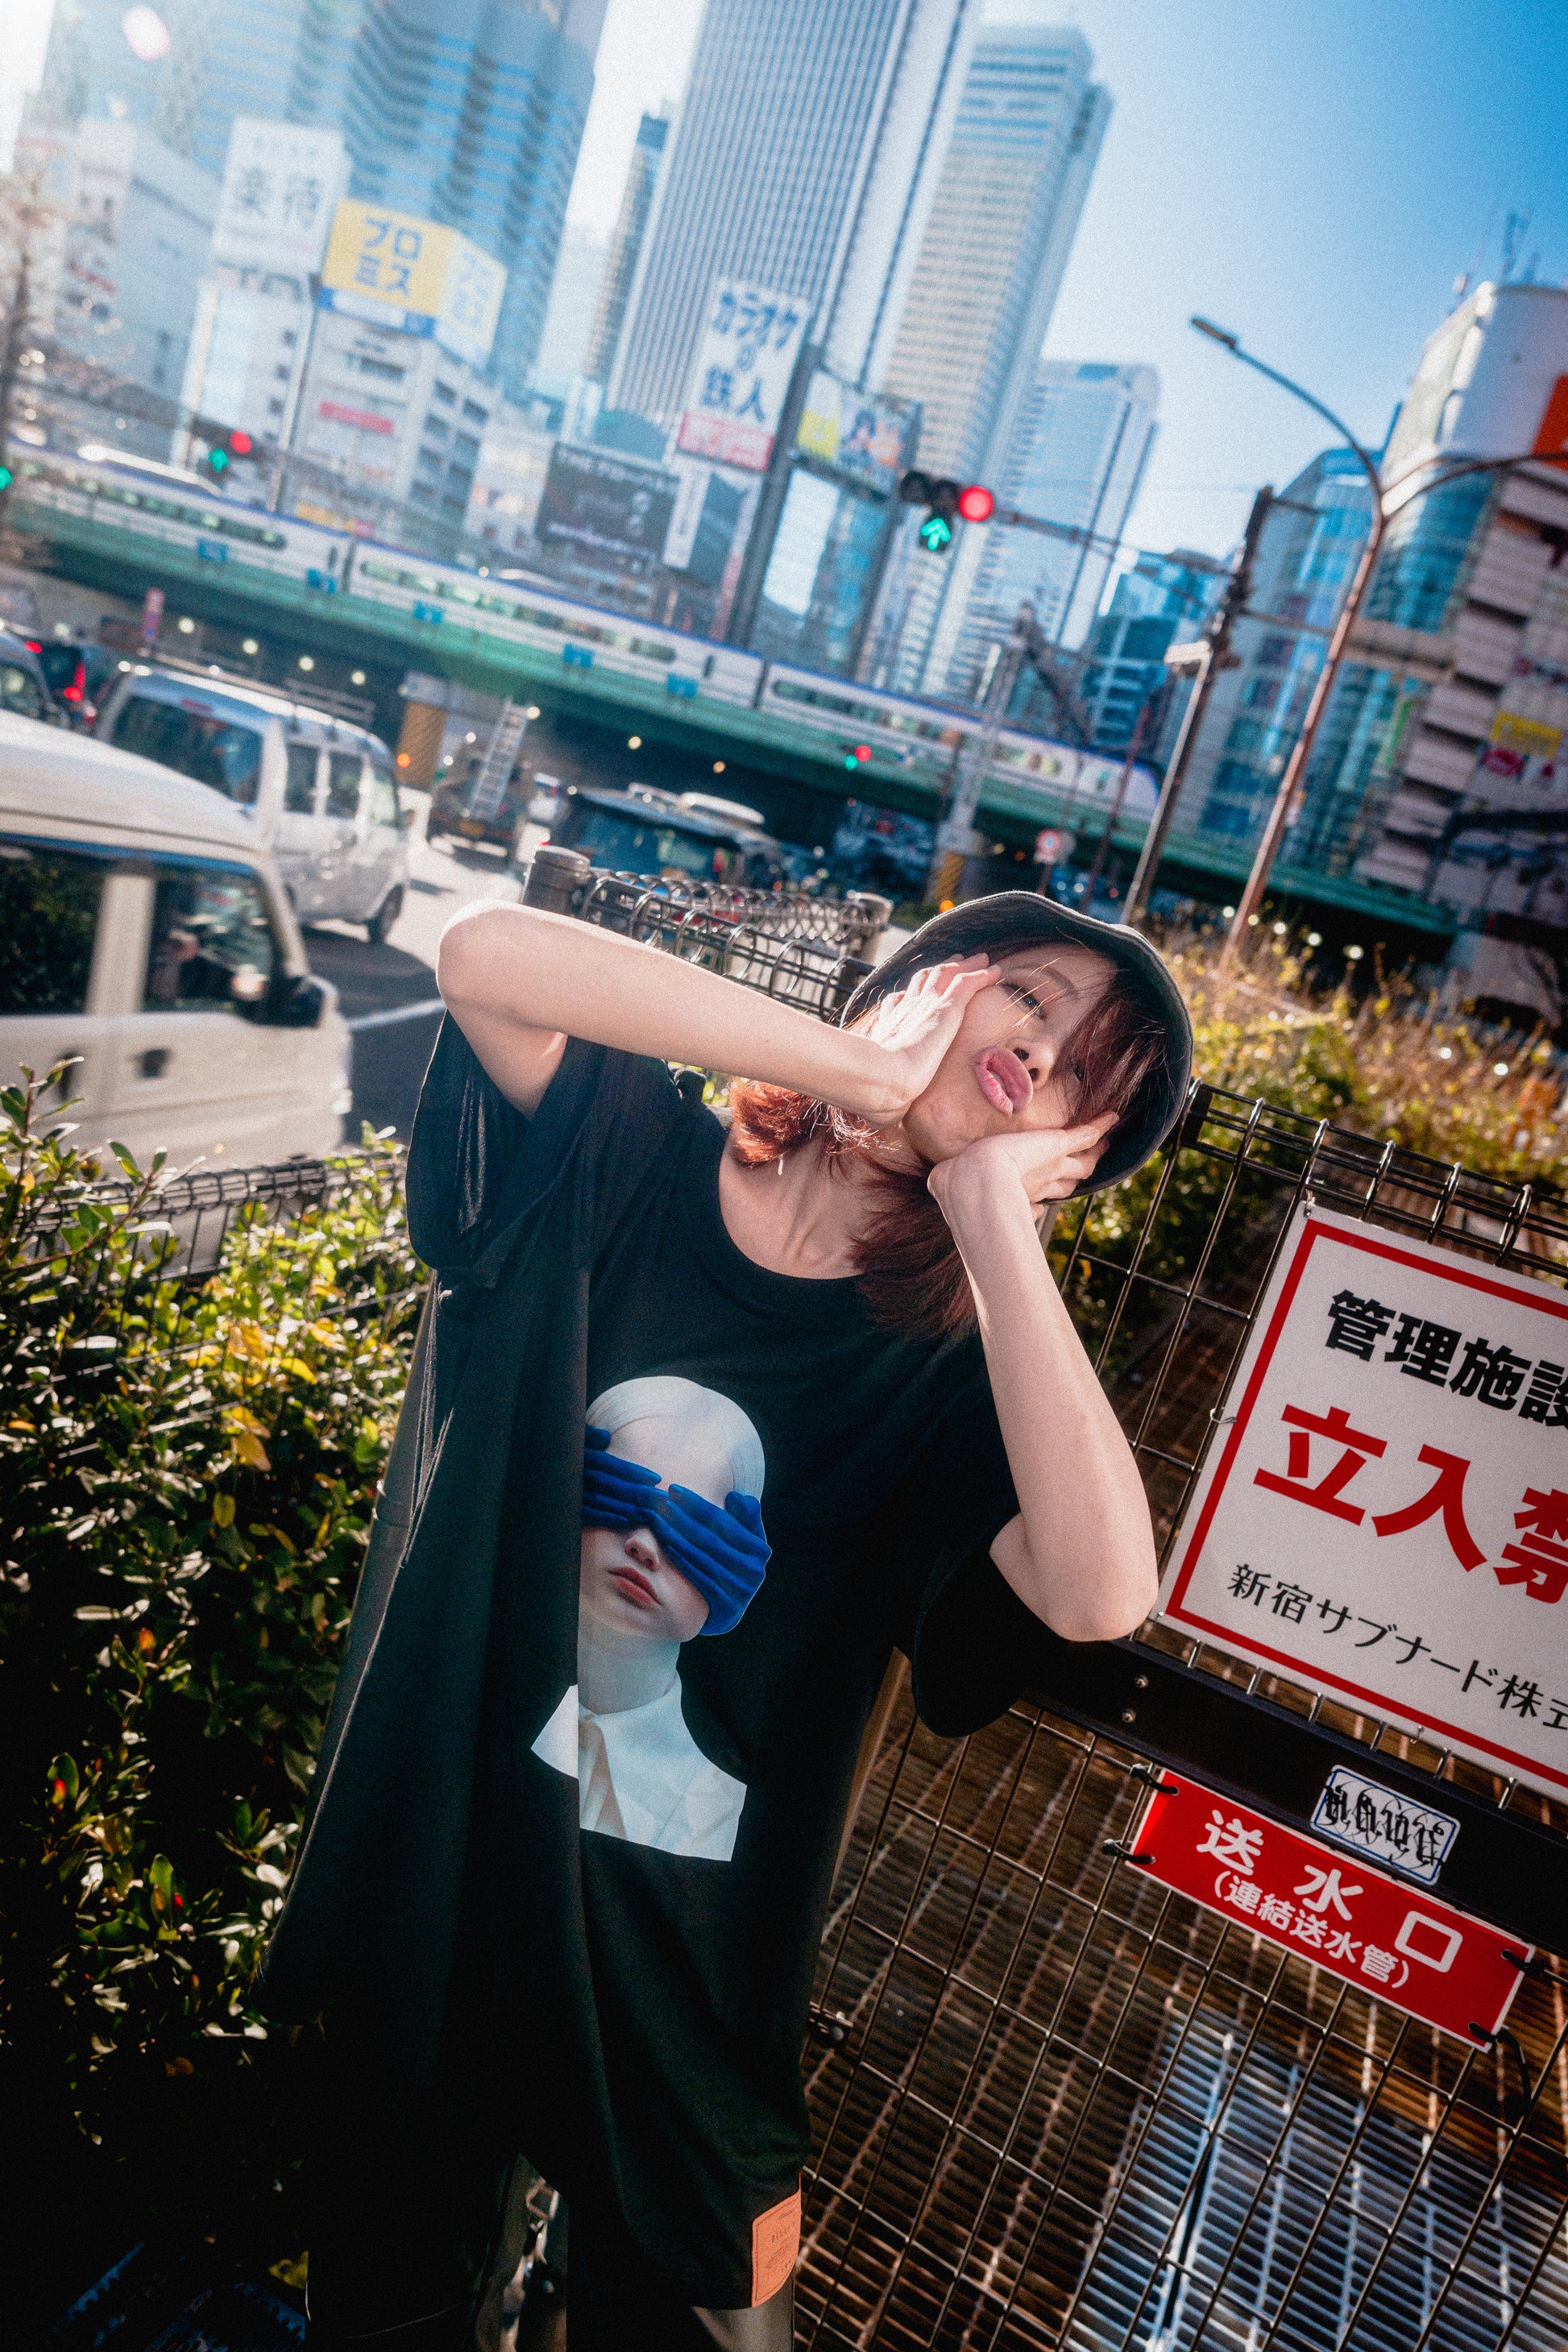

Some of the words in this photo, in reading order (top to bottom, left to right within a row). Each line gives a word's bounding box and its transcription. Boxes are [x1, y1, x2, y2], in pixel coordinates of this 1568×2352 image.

[354, 255, 413, 297] ミス
[363, 215, 424, 262] プロ
[1196, 1809, 1463, 1973] 送水口
[1214, 1870, 1410, 1989] (連結送水管)
